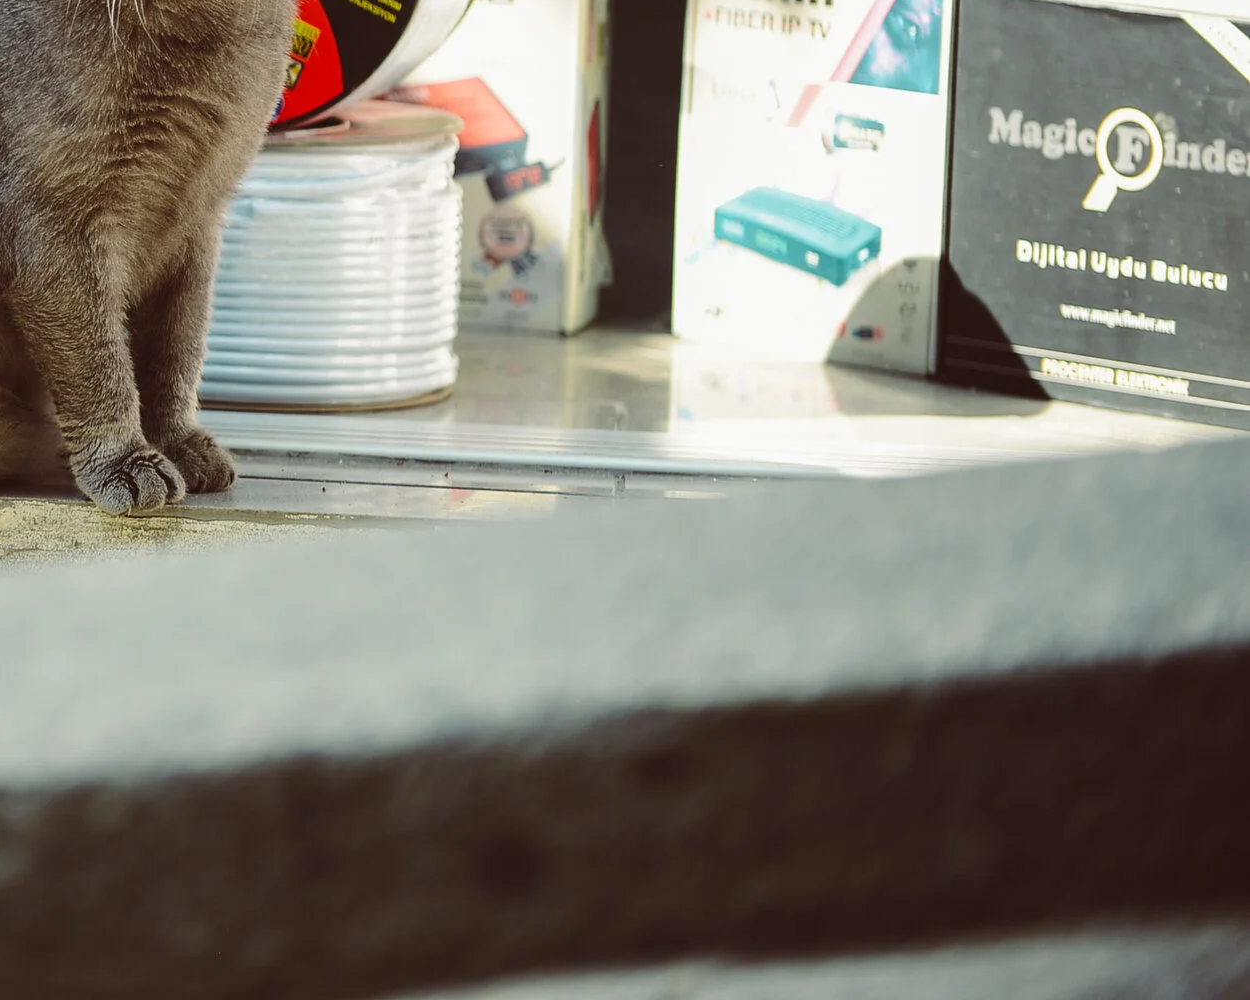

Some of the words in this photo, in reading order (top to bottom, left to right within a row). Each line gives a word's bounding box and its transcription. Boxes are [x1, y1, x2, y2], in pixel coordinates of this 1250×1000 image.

[715, 5, 775, 33] FIBER
[781, 12, 801, 35] IP
[808, 17, 832, 39] TV
[988, 106, 1097, 160] Magic
[1113, 124, 1250, 178] Finde
[1089, 250, 1148, 281] Uydu
[1150, 259, 1229, 292] Bulucu
